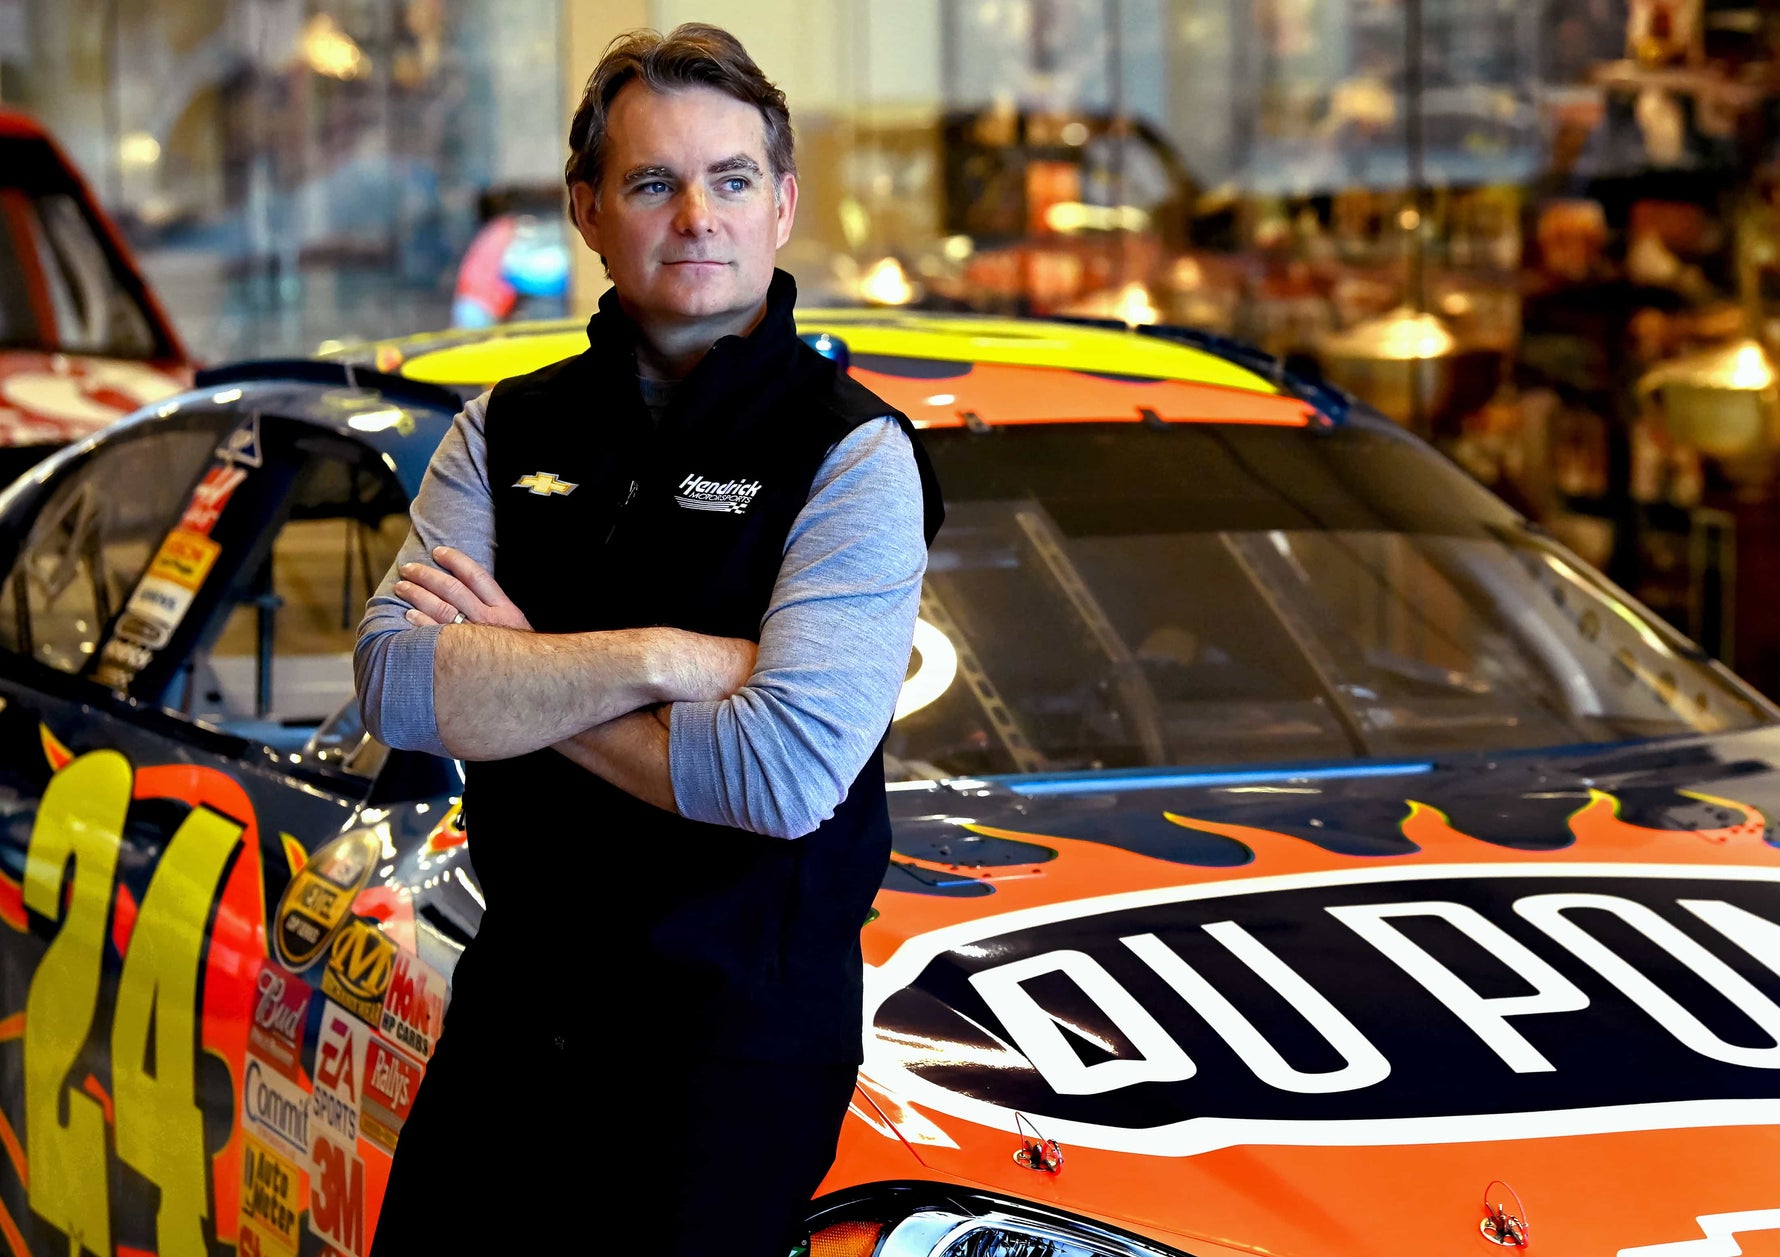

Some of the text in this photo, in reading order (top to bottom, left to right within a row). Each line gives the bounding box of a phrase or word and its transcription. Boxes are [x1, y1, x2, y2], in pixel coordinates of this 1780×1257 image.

[679, 474, 762, 497] Hendrick
[689, 492, 752, 503] MOTORSPORTS
[22, 749, 247, 1257] 24
[255, 967, 308, 1040] Bud
[382, 1011, 429, 1057] HP CARBS
[968, 920, 1392, 1095] DU
[317, 1017, 356, 1104] EA
[370, 1049, 410, 1110] Rally's
[245, 1059, 311, 1149] Commit
[313, 1085, 357, 1140] SPORTS
[256, 1151, 288, 1199] Auto
[310, 1136, 364, 1257] 3M
